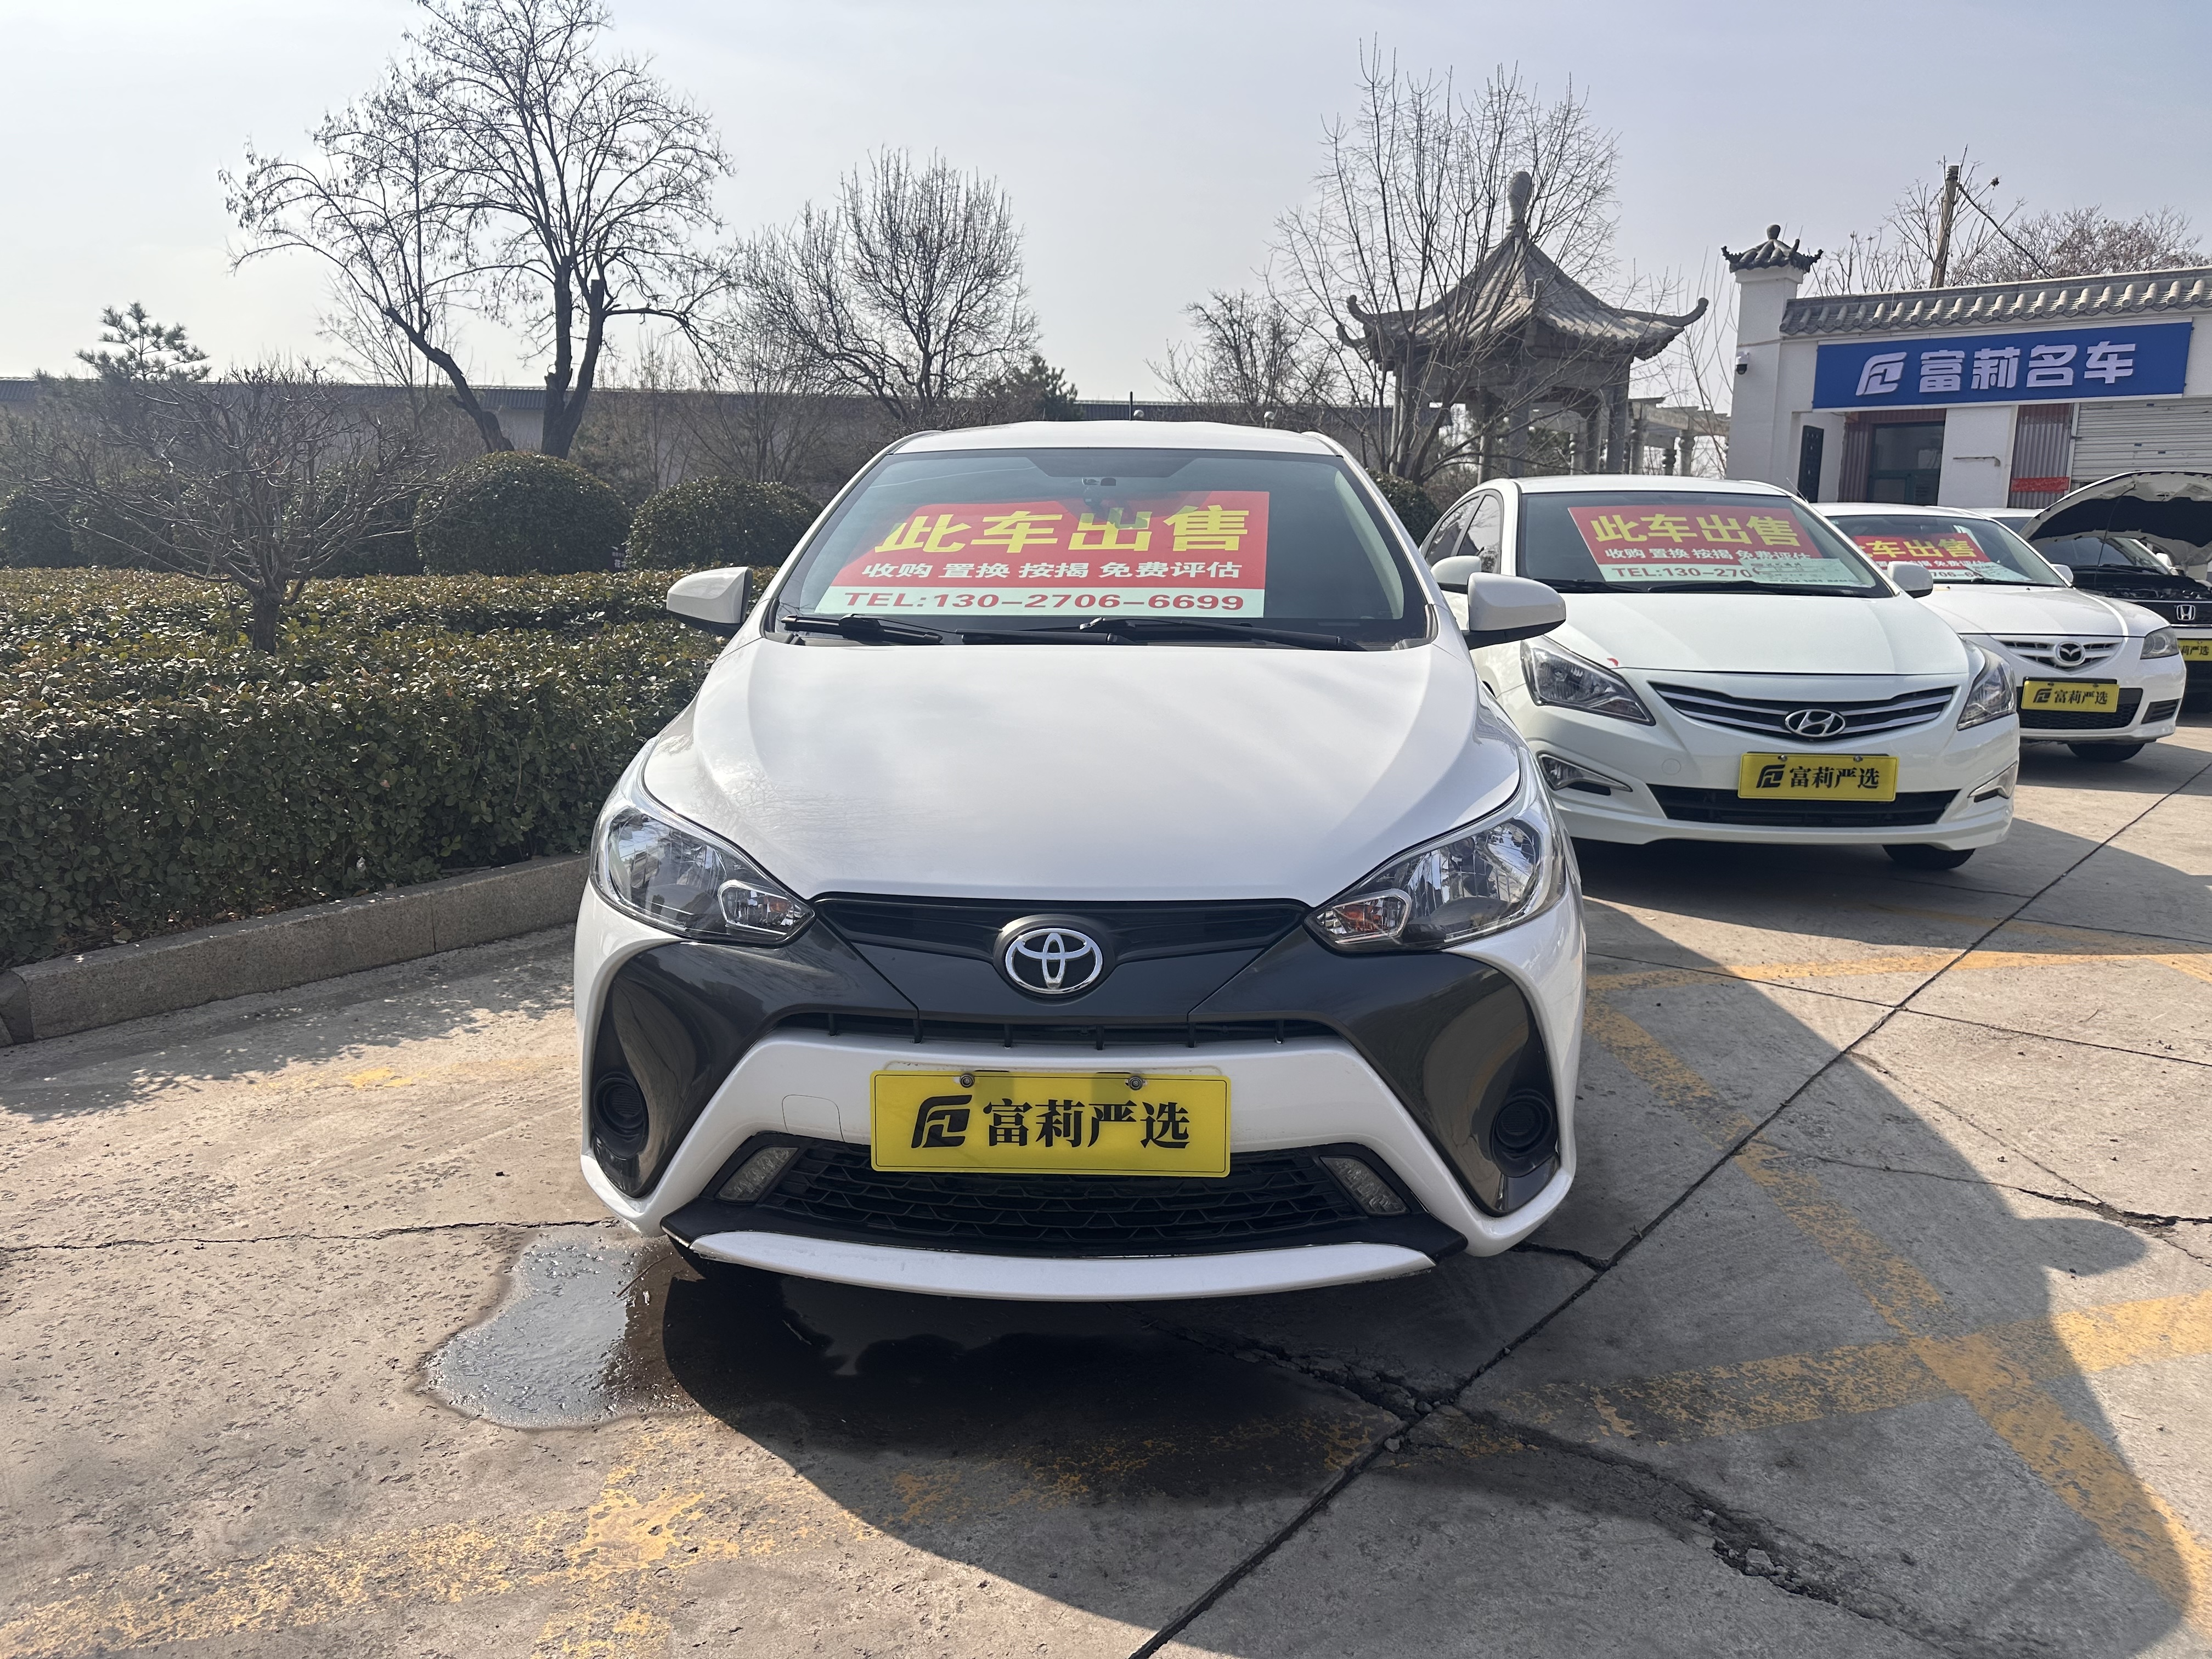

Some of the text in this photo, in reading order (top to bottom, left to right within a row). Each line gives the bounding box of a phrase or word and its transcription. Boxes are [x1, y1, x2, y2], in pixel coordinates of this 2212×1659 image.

[1919, 341, 2136, 393] 富莉名车
[875, 505, 1249, 553] 此车出售
[1591, 514, 1801, 546] 此车出售
[1605, 548, 1646, 558] 收购
[1649, 548, 1690, 558] 置换
[1692, 549, 1733, 559] 按揭
[1859, 539, 1977, 558] 车出售
[862, 562, 1242, 578] 收购 置换 按揭 免费评估
[2179, 645, 2209, 656] 莉严选
[2054, 689, 2108, 704] 富莉严选
[1790, 766, 1880, 789] 富莉严选
[983, 1098, 1190, 1148] 富莉严选
